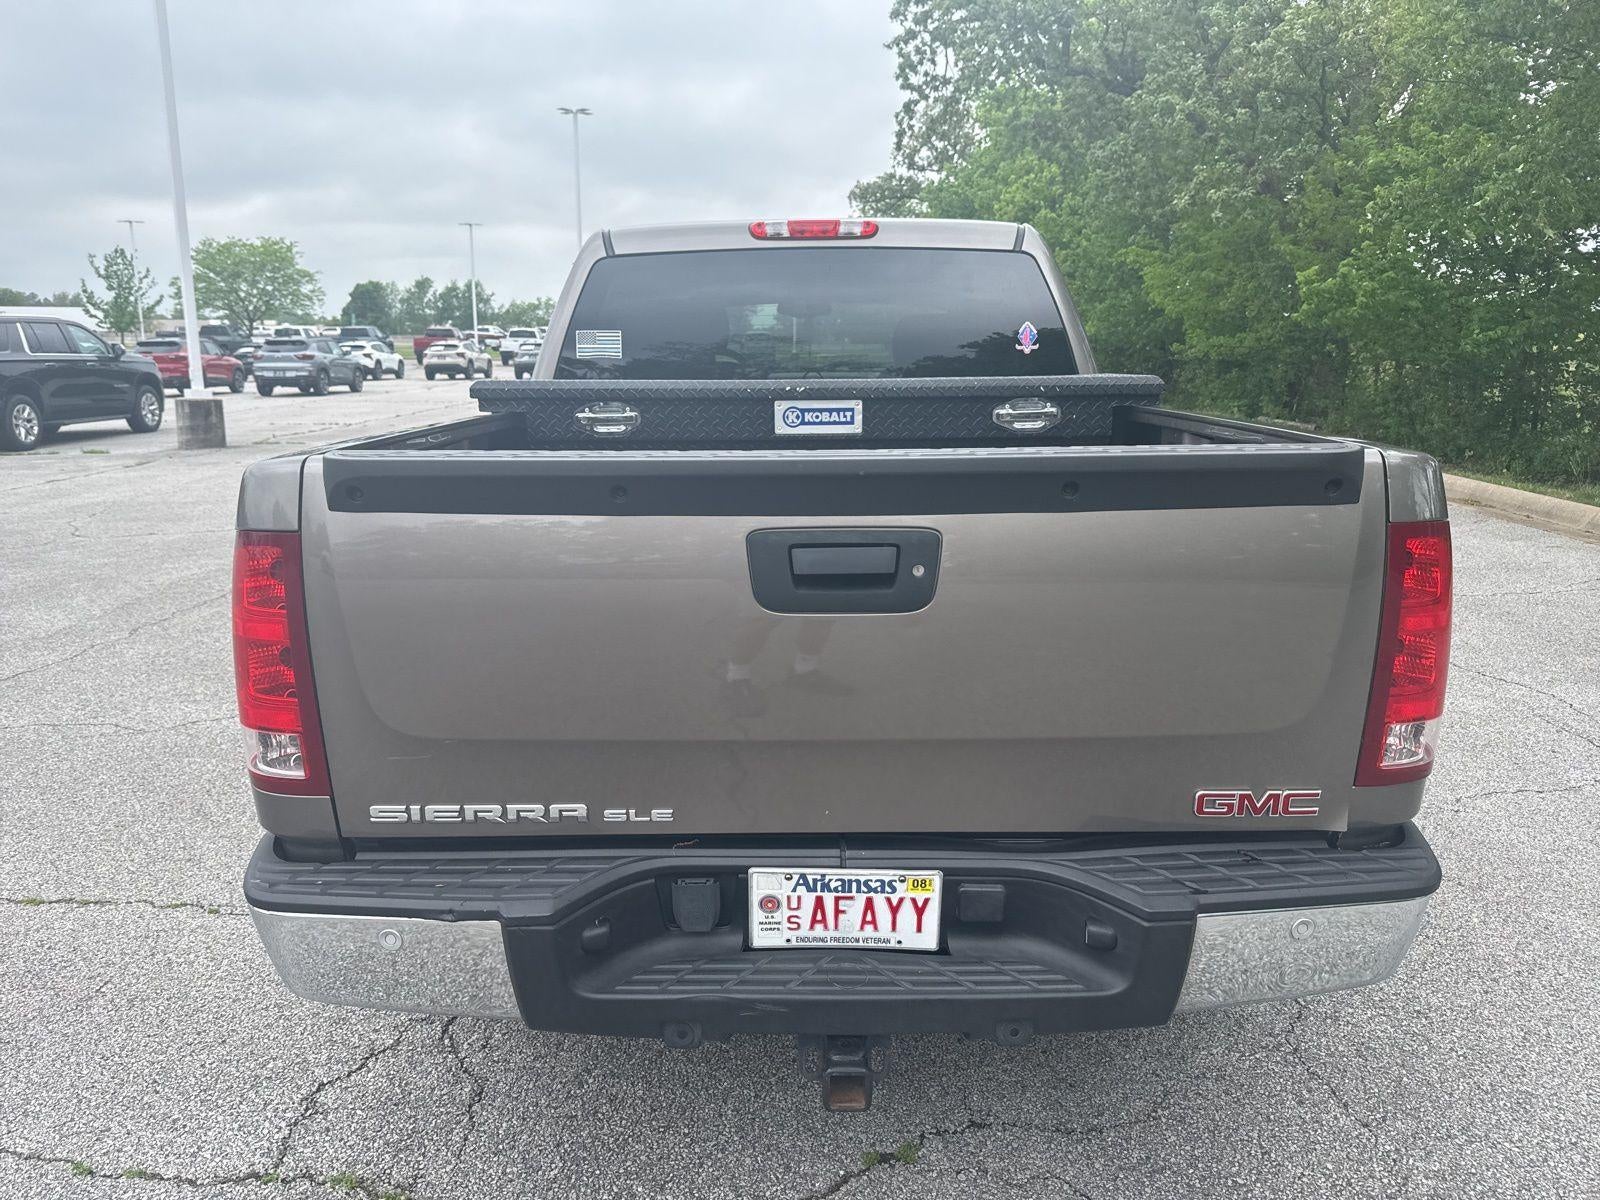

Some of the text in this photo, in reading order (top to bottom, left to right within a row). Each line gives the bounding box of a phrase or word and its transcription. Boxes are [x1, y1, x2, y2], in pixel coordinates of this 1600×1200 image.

[804, 411, 853, 423] KOBALT
[1194, 790, 1322, 817] GMC
[369, 804, 674, 824] SIERRA SLE
[791, 872, 898, 895] Arkansas
[912, 878, 927, 889] 08
[808, 895, 931, 933] AFAYY
[795, 936, 891, 945] ENDURING FREEDOM VETERAN
